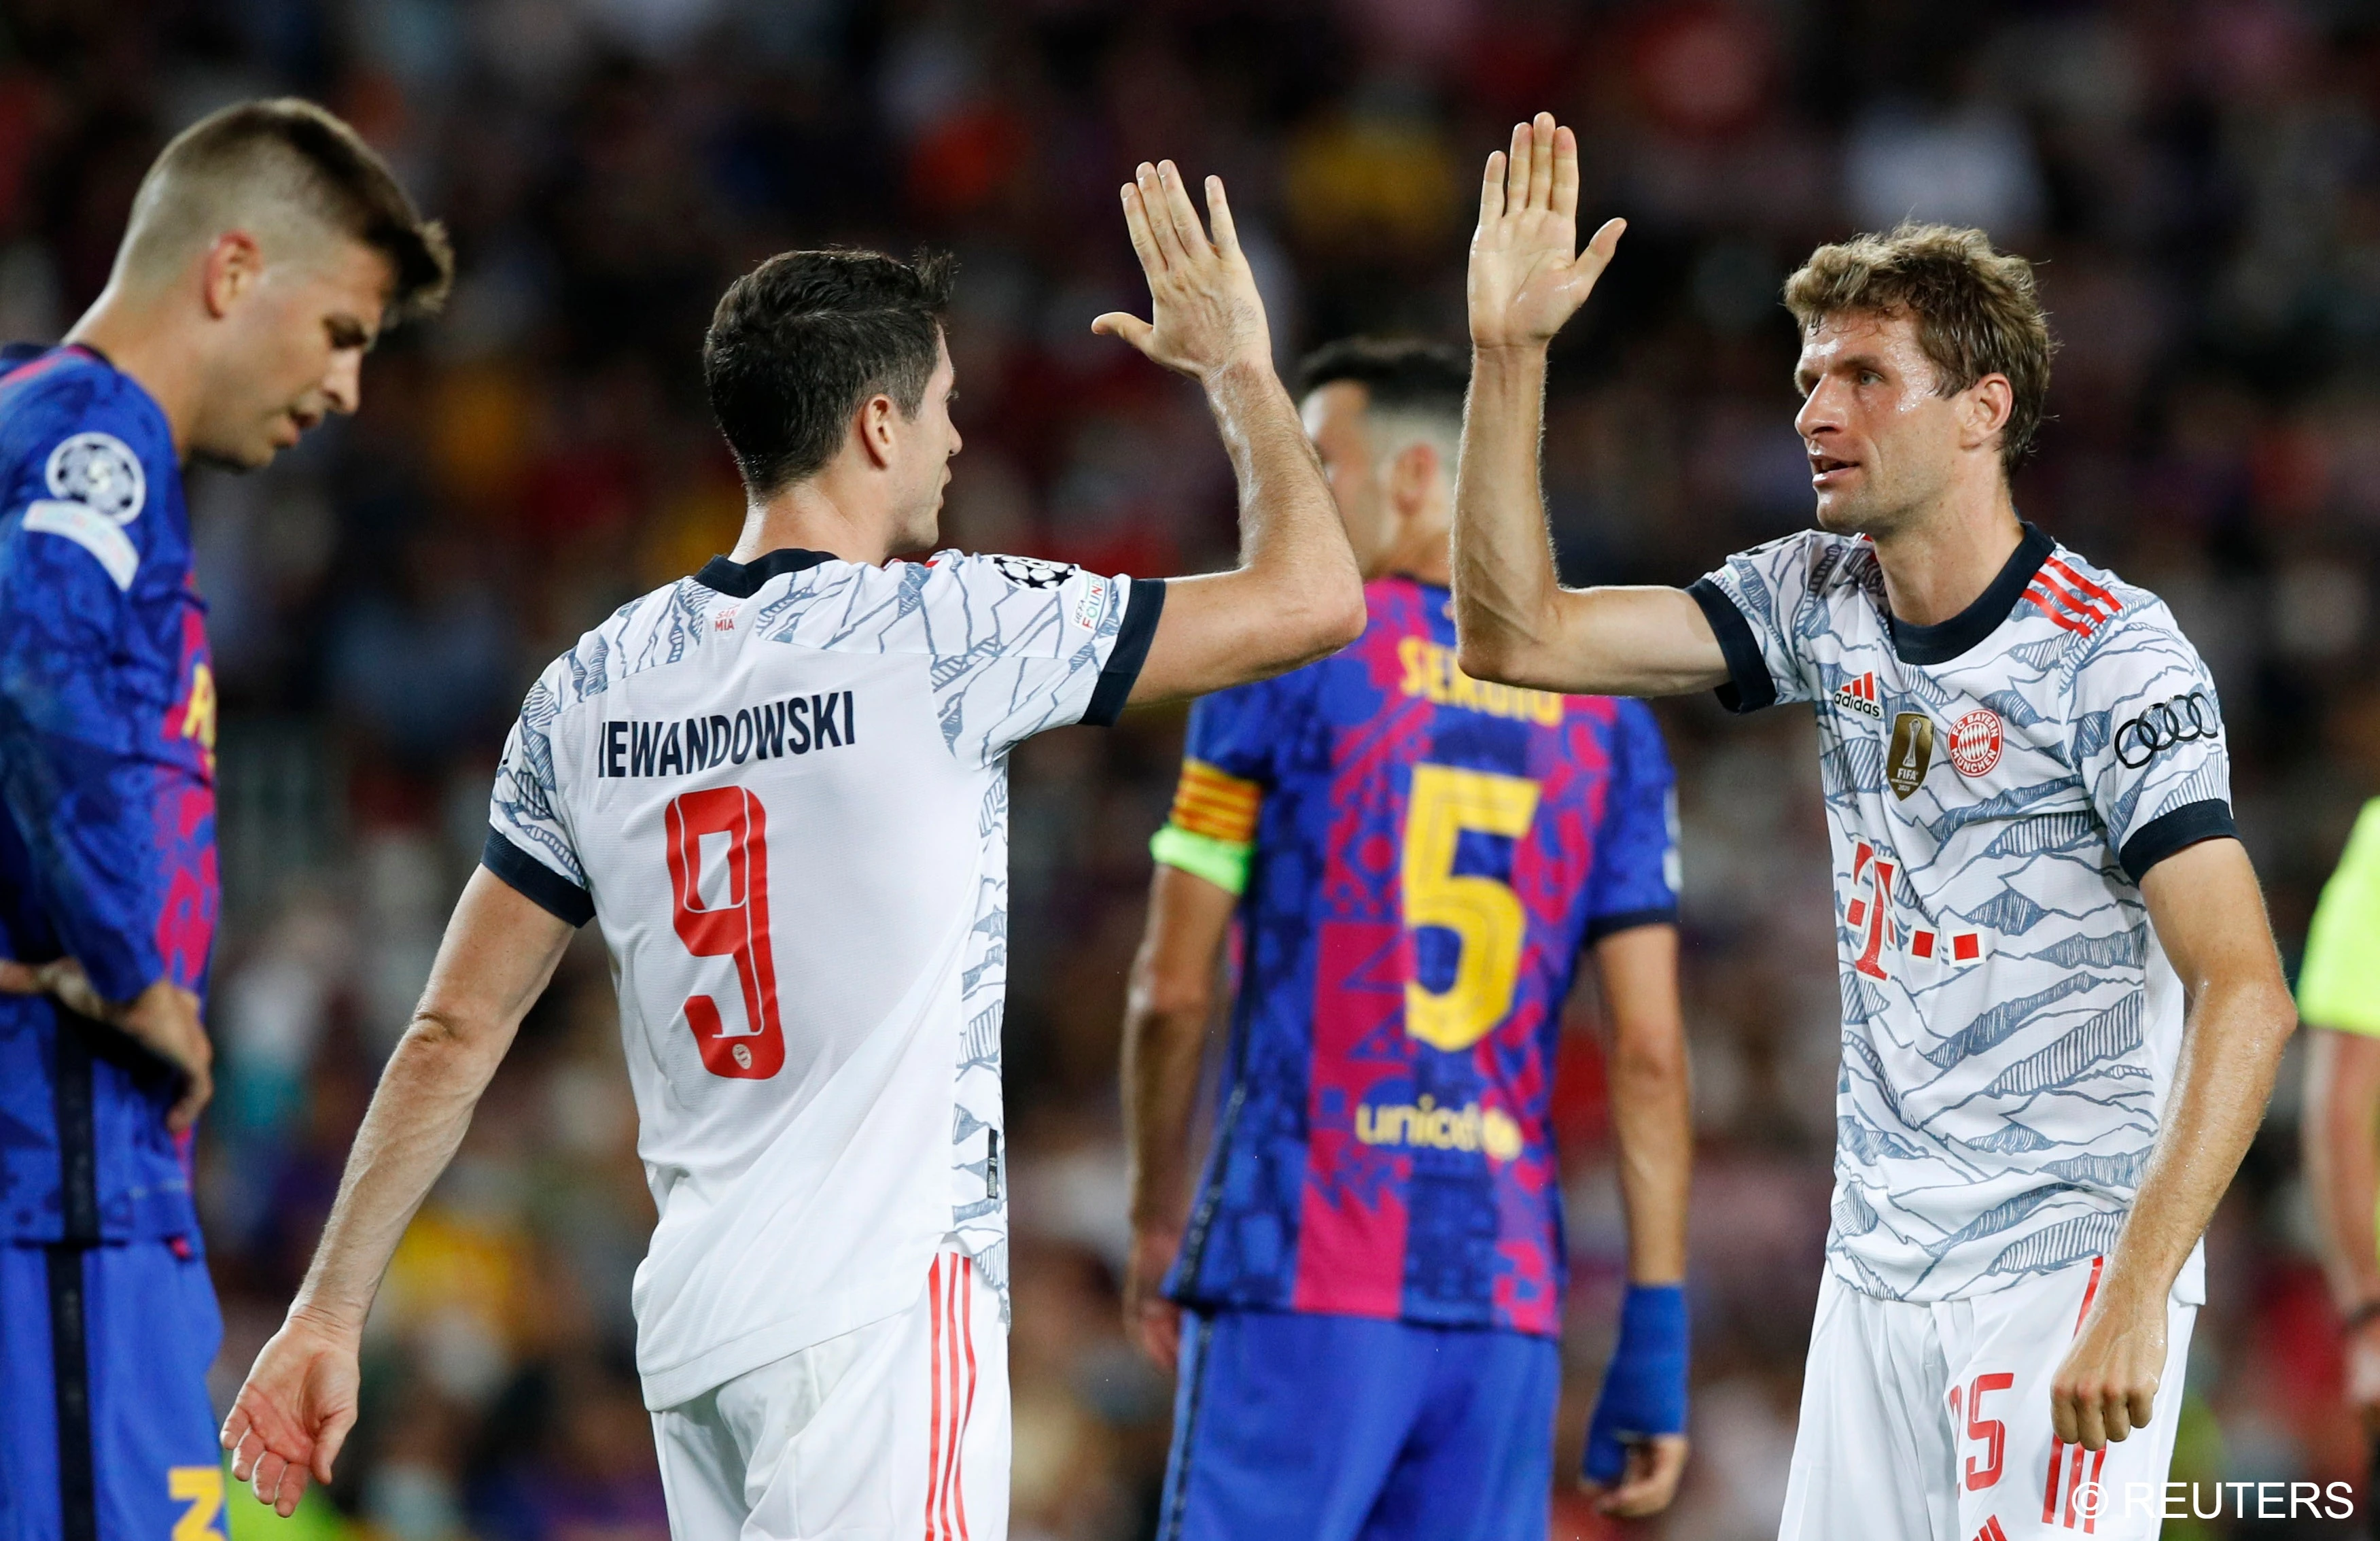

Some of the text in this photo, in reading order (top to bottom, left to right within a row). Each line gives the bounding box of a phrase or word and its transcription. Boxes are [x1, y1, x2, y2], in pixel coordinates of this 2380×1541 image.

[715, 619, 735, 631] MIA
[1834, 693, 1880, 717] adidas
[1952, 712, 1999, 738] FC BAYERN
[1951, 747, 1997, 772] MÜNCHEN
[1897, 767, 1917, 781] FIFA
[1402, 763, 1541, 1052] 5
[665, 785, 785, 1080] 9
